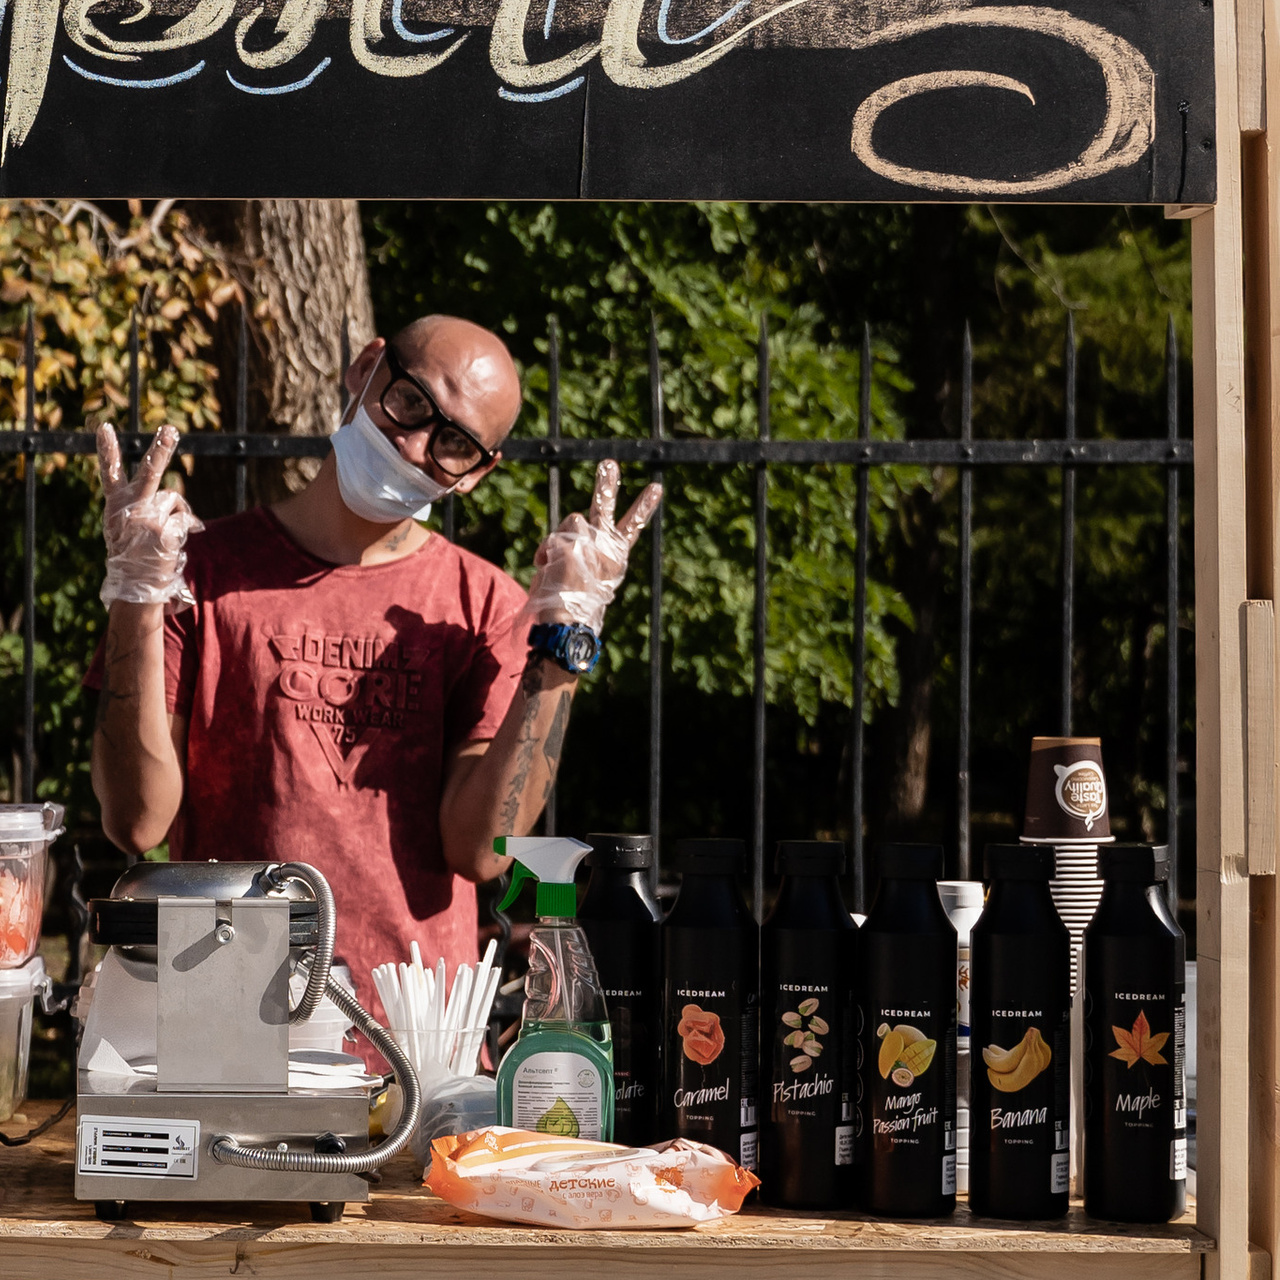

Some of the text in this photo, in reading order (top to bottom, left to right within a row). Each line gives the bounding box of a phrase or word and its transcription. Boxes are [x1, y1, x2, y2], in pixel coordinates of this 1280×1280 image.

[303, 632, 398, 668] DENIM
[280, 663, 421, 710] CORE
[295, 704, 404, 727] WORK WEAR
[1064, 780, 1104, 793] Quality
[1070, 791, 1101, 804] Taste
[677, 989, 726, 998] ICEDREAM
[779, 984, 829, 992] ICEDREAM
[1114, 992, 1166, 1001] ICEDREAM
[880, 1009, 931, 1018] ICEDREAM
[991, 1009, 1043, 1018] ICEDREAM
[615, 1080, 645, 1101] olate
[674, 1077, 730, 1108] Caramel
[773, 1073, 834, 1103] Pistachio
[885, 1093, 922, 1115] Mango
[1115, 1086, 1161, 1120] Maple
[873, 1115, 910, 1135] Passion
[911, 1107, 938, 1132] fruit
[990, 1107, 1048, 1130] Banana
[890, 1137, 920, 1145] TOPPING
